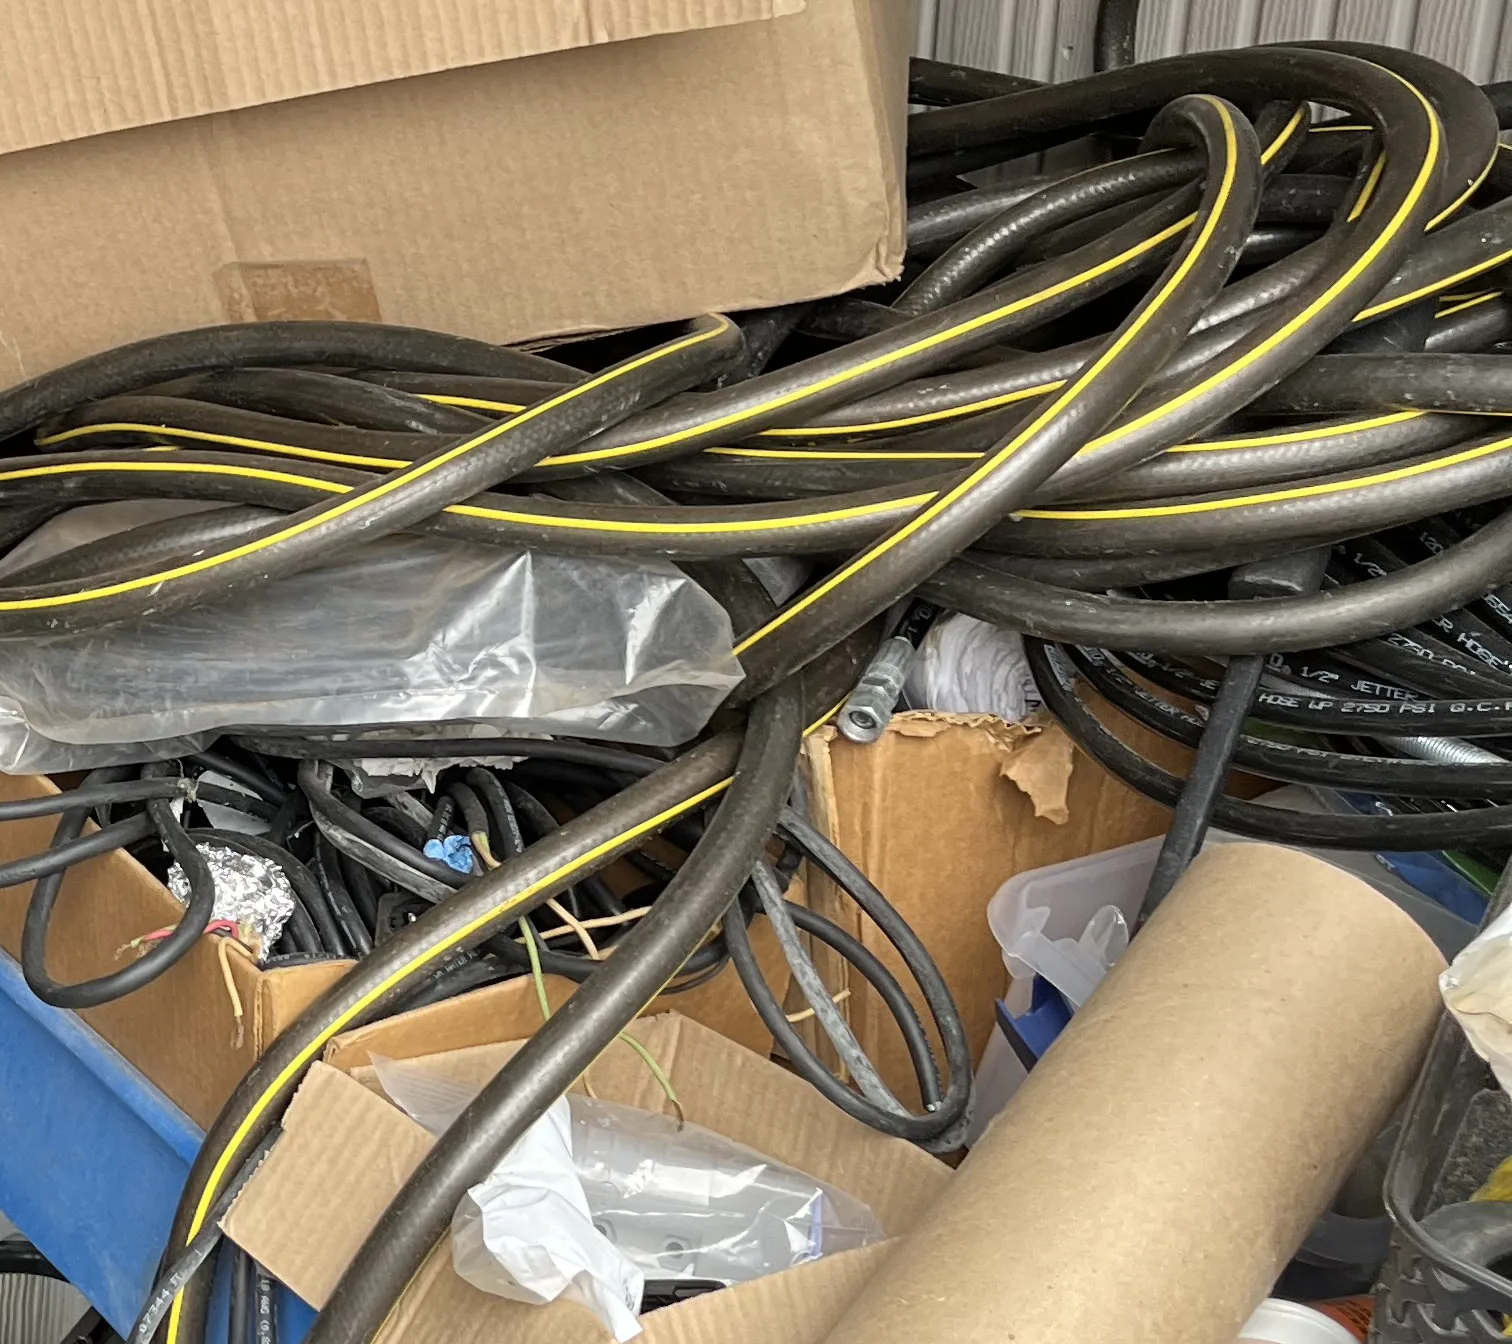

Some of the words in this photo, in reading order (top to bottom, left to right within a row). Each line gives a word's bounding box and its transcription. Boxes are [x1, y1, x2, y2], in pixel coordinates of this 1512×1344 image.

[1350, 679, 1420, 702] JETTER
[1258, 693, 1300, 708] HOSE
[1308, 699, 1334, 711] WP
[1340, 702, 1390, 714] 2750
[1399, 702, 1436, 714] PSI
